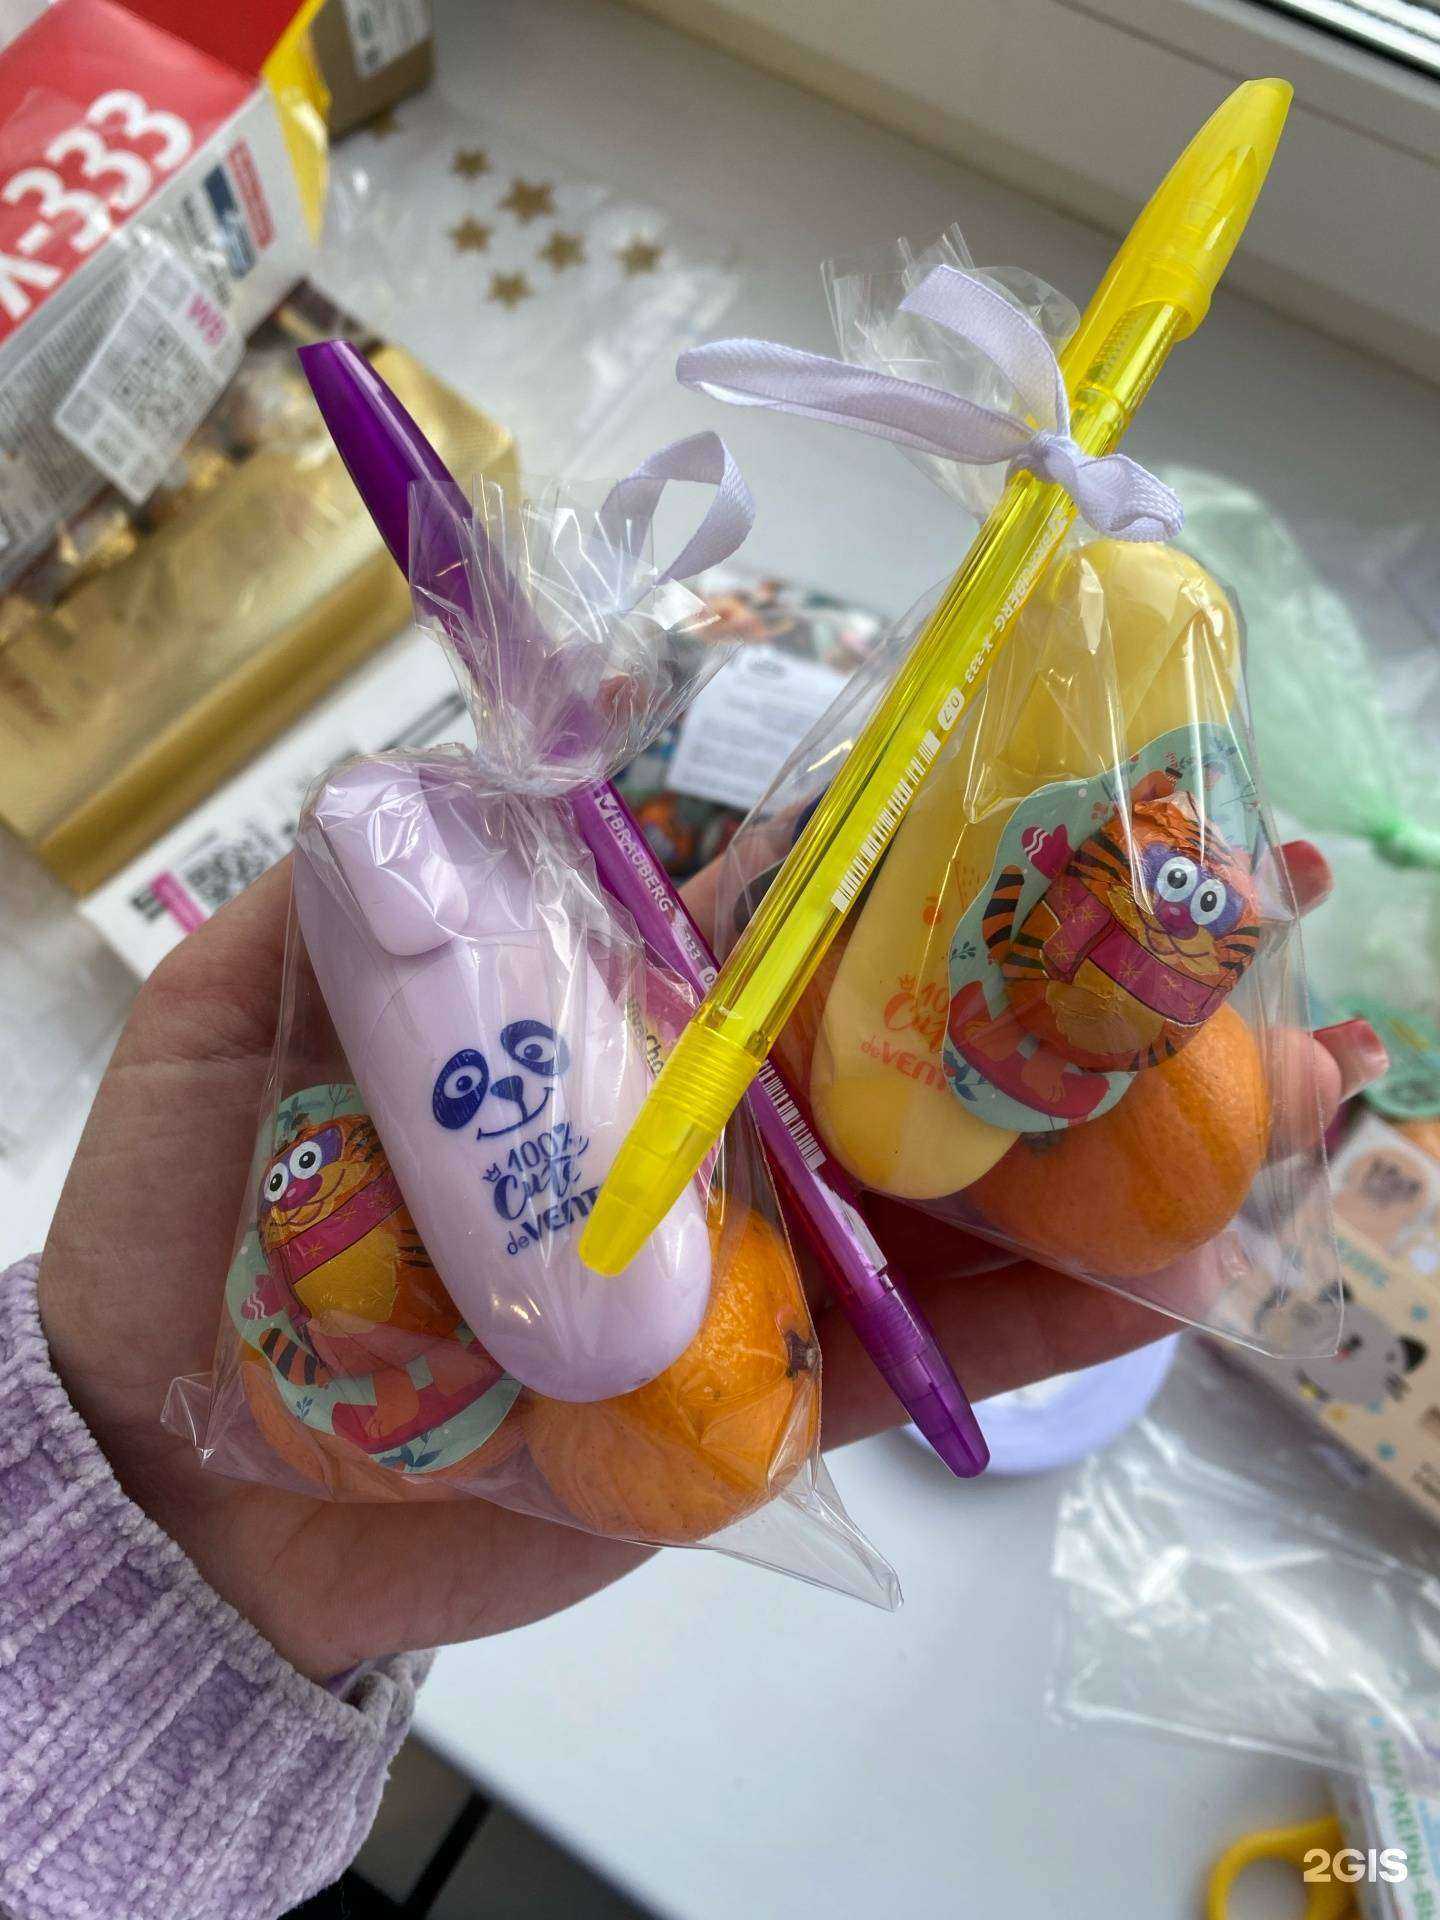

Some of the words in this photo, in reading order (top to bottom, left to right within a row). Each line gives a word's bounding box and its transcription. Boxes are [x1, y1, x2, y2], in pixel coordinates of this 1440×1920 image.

[965, 633, 993, 683] X-333
[943, 695, 960, 724] 0.7
[609, 816, 674, 913] BRAUBERG
[883, 990, 949, 1053] Cut
[507, 1121, 574, 1173] 100%
[493, 1154, 578, 1221] Cute
[506, 1185, 600, 1256] deVENT
